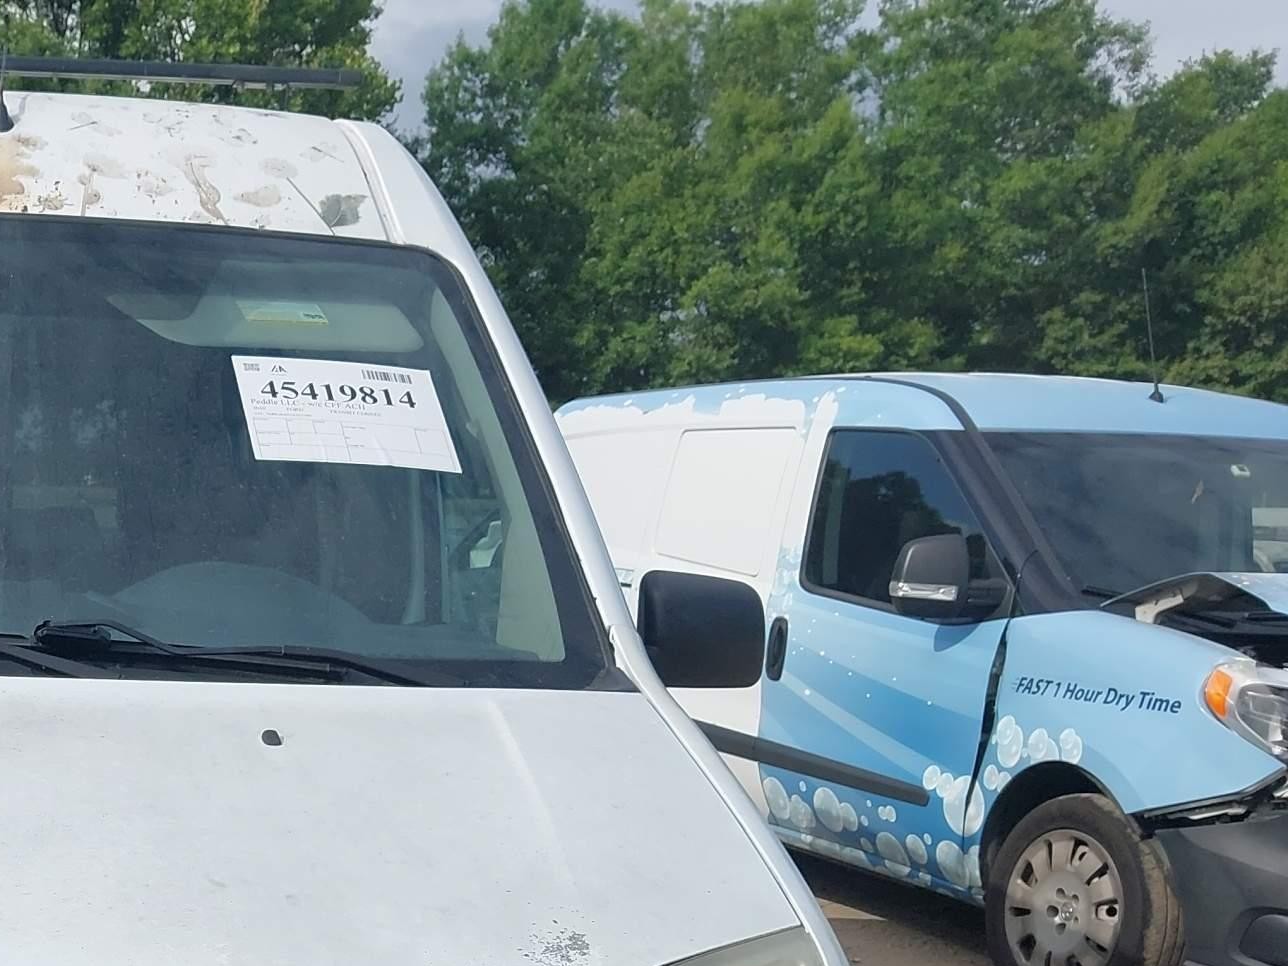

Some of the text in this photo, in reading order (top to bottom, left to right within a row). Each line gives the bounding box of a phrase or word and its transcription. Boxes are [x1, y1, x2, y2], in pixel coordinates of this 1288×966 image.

[261, 380, 417, 409] 45419814
[1016, 677, 1182, 713] FAST 1 Hour Dry Time
